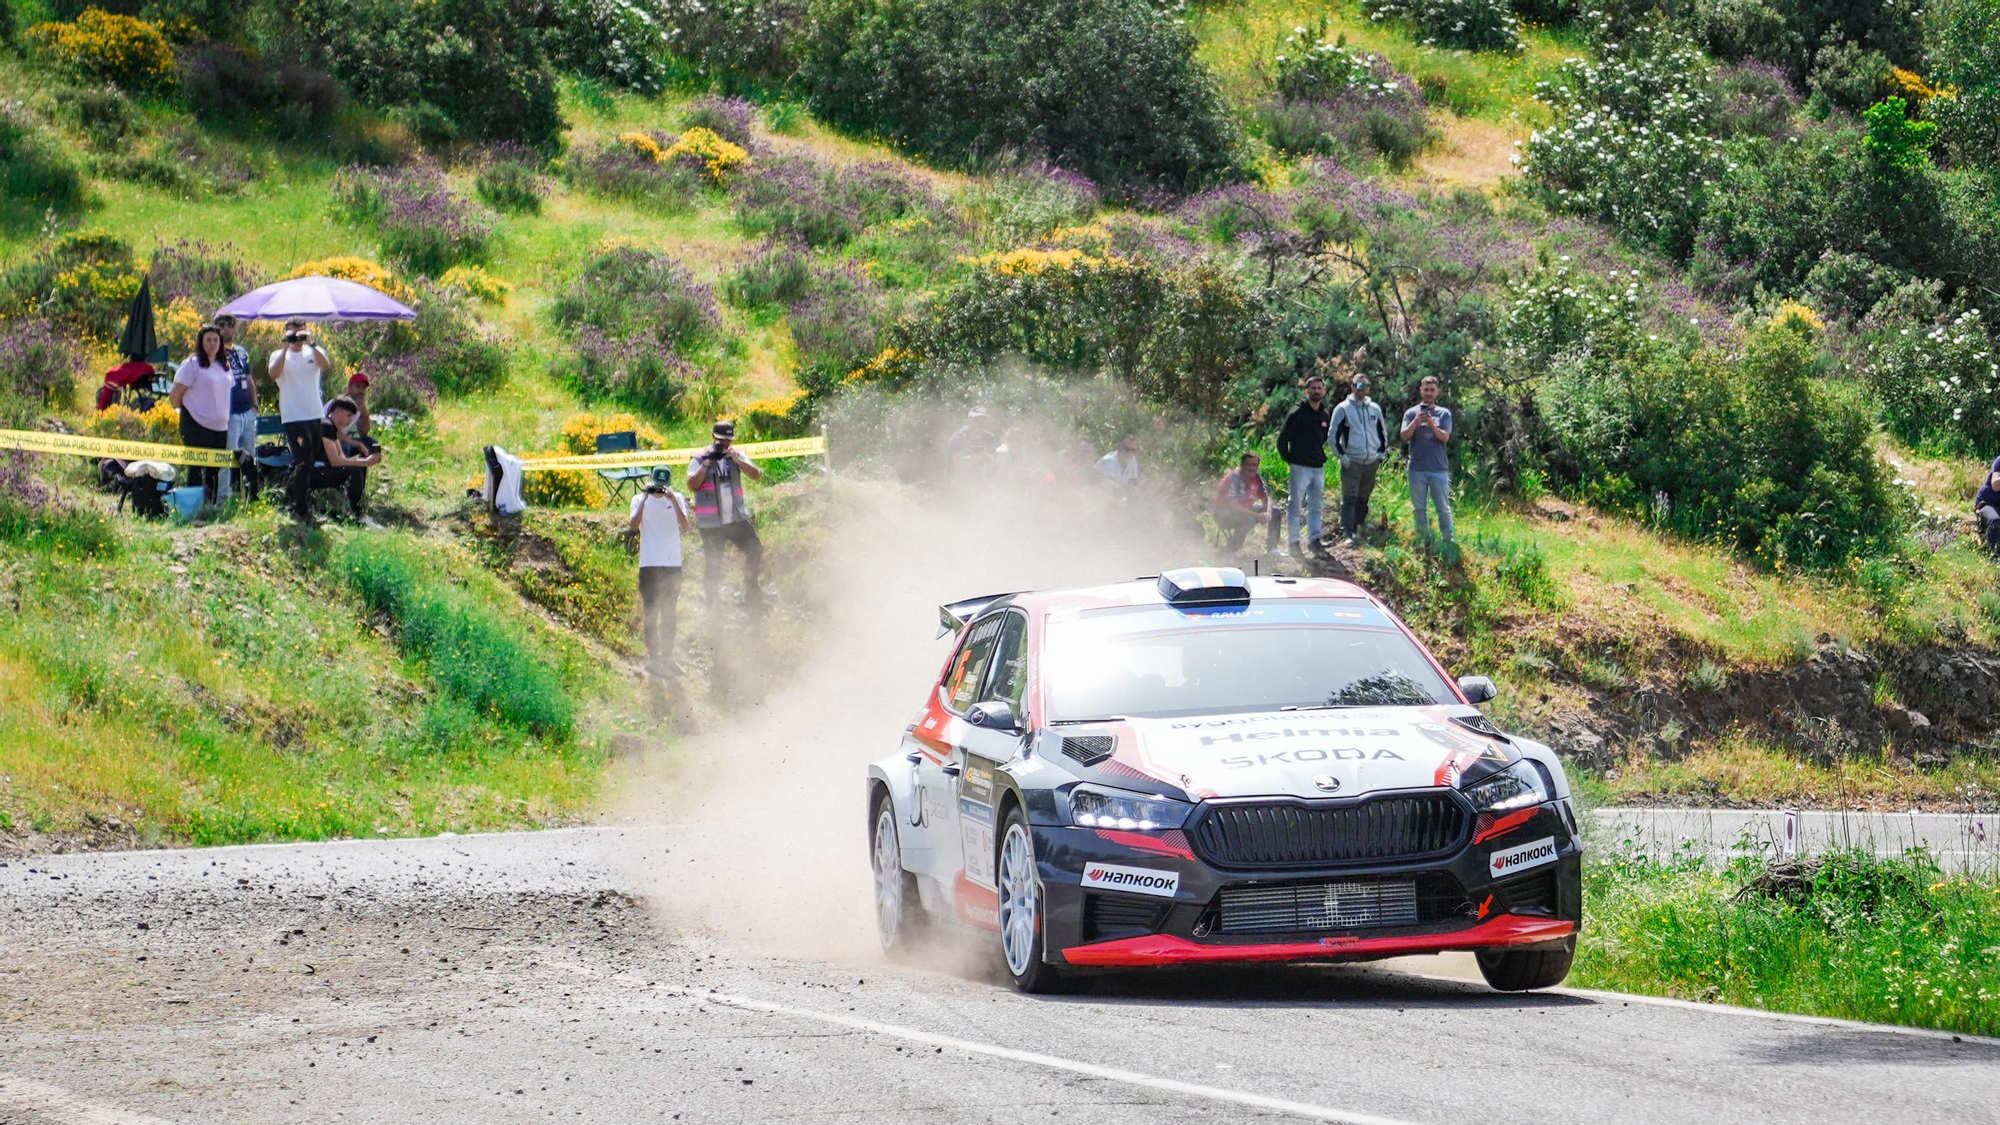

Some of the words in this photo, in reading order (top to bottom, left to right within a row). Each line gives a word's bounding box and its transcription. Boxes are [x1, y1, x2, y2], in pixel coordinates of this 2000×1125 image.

[53, 437, 70, 449] ZONA
[72, 440, 100, 452] PUBLICO
[107, 443, 125, 454] ZONA
[126, 446, 155, 458] PUBLICO
[161, 448, 179, 459] ZONA
[180, 451, 208, 462] PUBLICO
[623, 453, 645, 463] ZONA
[647, 452, 681, 462] PUBLICO
[755, 445, 777, 455] ZONA
[778, 441, 813, 453] PUBLICO
[1211, 611, 1250, 619] RALLY
[1199, 727, 1401, 746] Helmia
